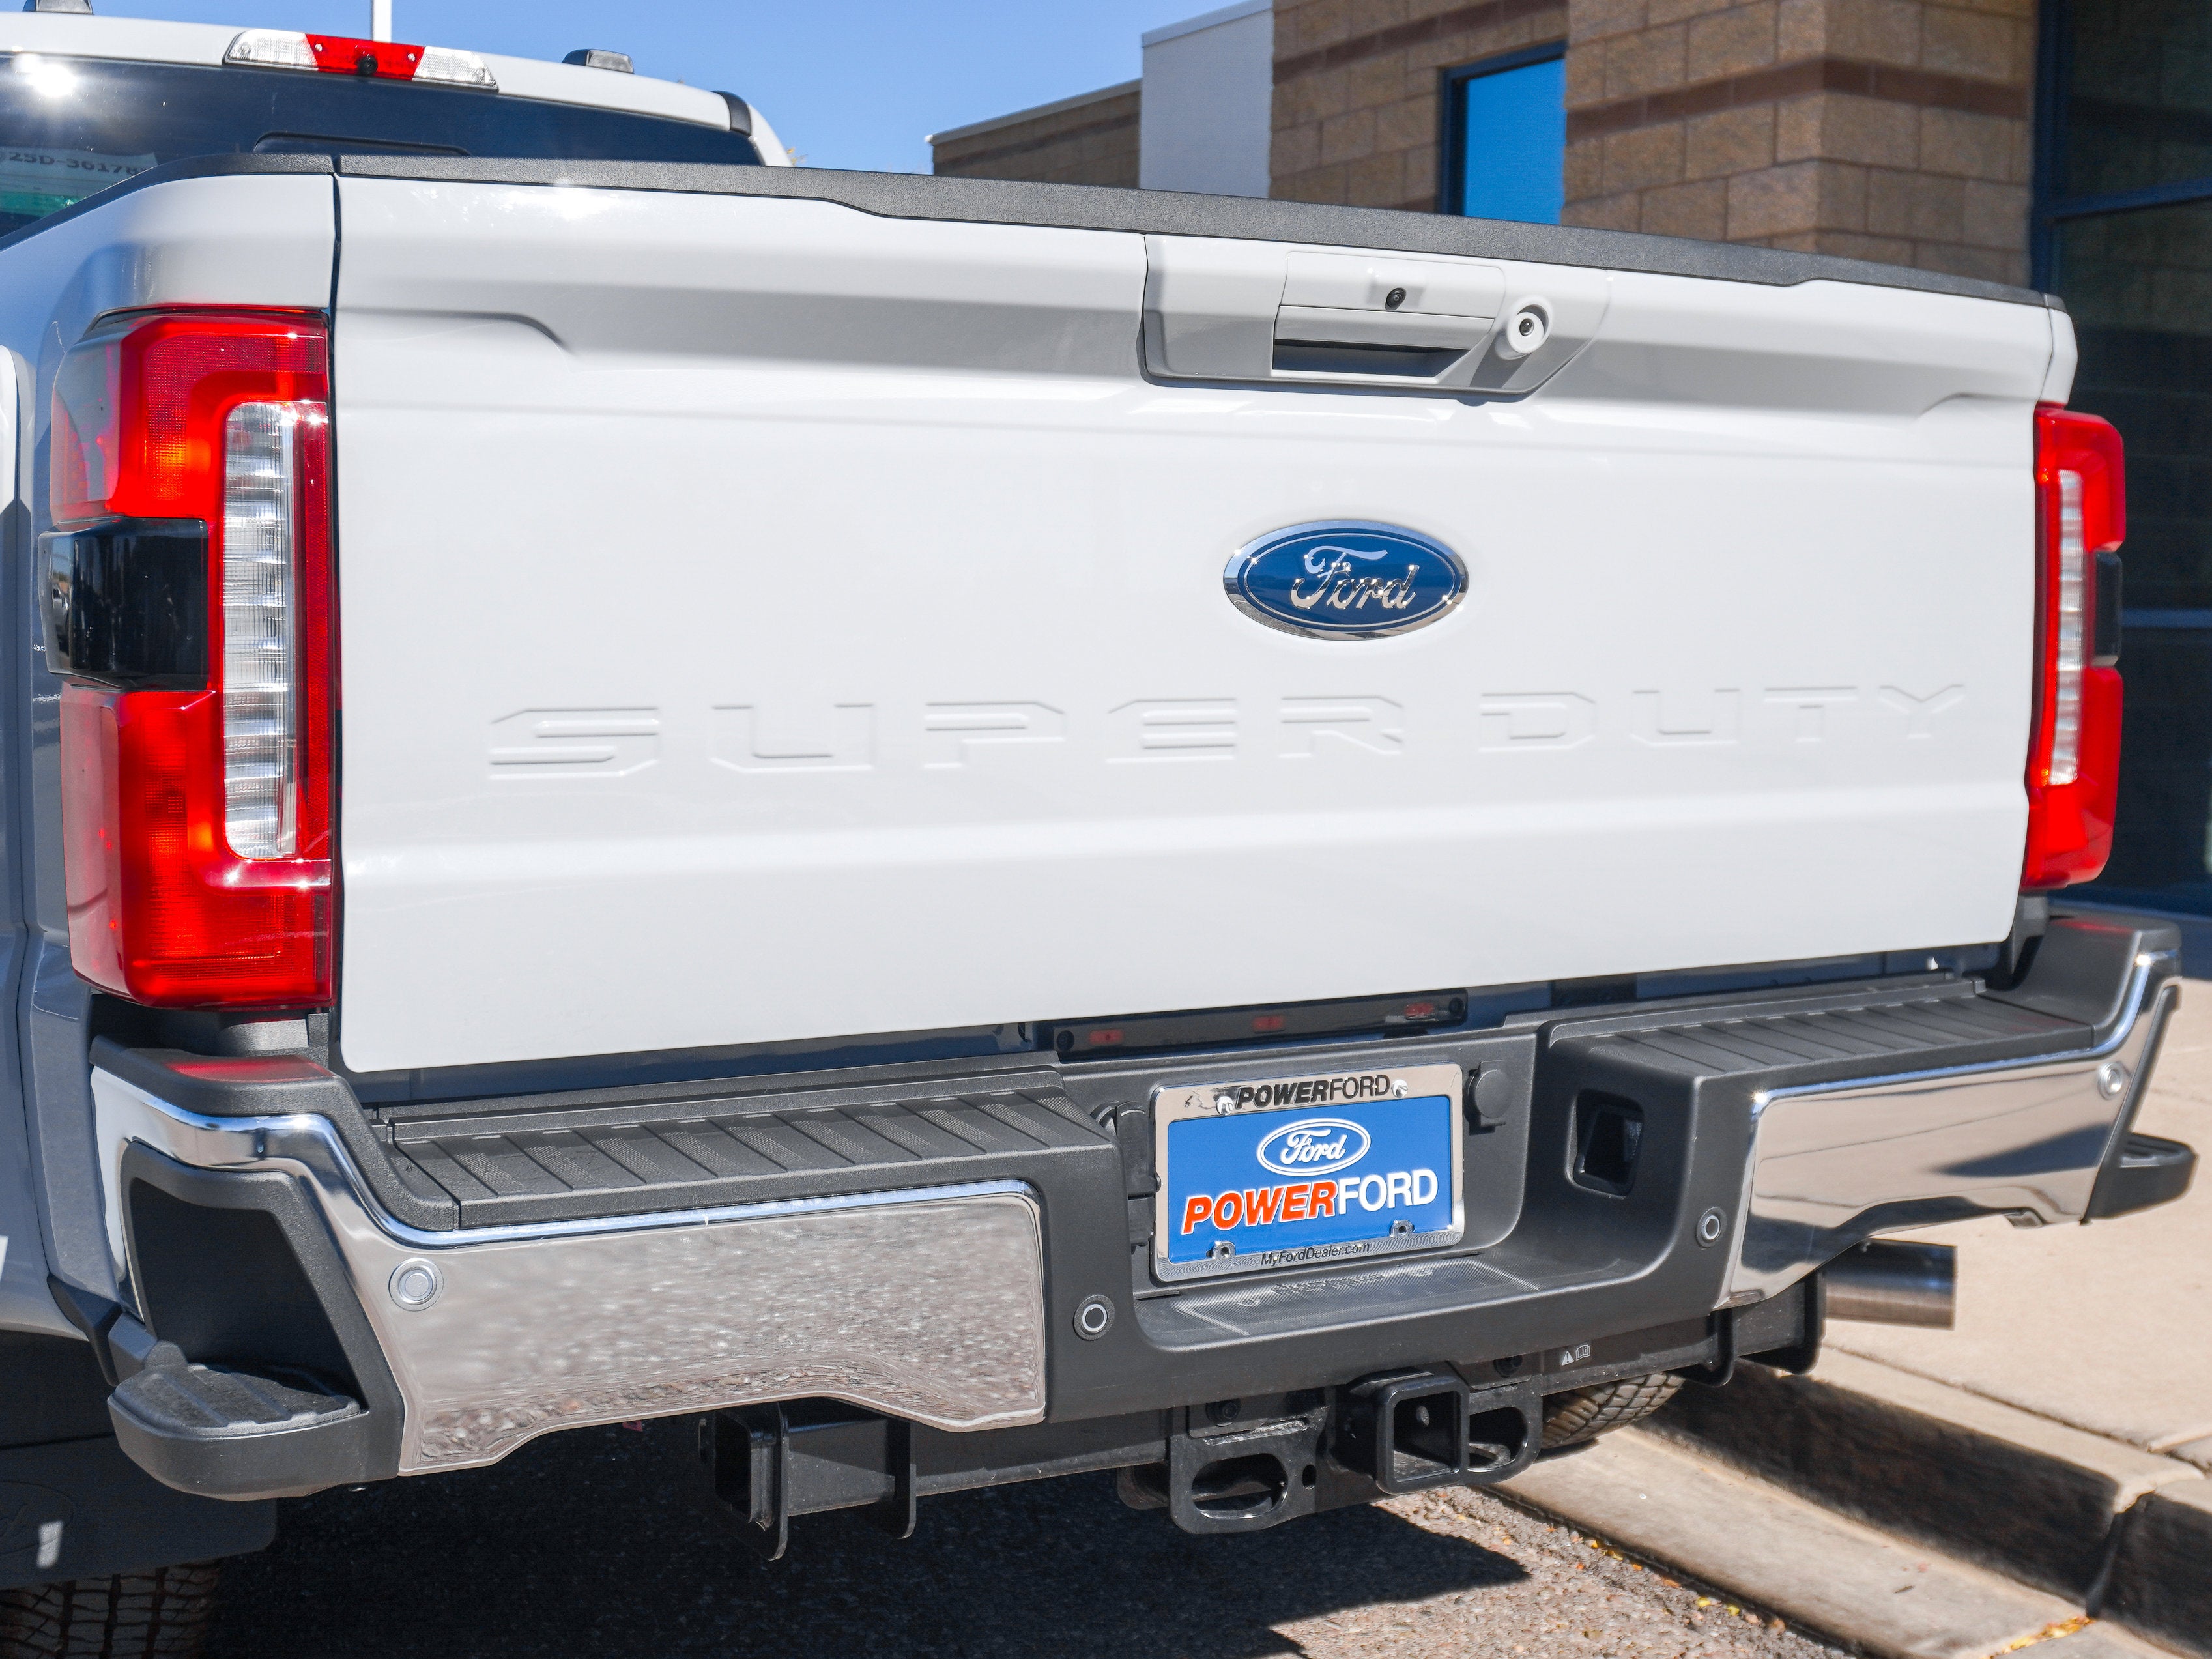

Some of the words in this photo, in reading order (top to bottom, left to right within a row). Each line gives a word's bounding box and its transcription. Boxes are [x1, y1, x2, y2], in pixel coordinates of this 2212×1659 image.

[1289, 545, 1420, 610] Ford
[487, 695, 1404, 780] SUPER
[1478, 683, 1966, 753] DUTY
[1235, 1074, 1390, 1109] POWERFORD
[1279, 1128, 1348, 1165] Ford
[1181, 1168, 1439, 1235] POWERFORD
[1261, 1243, 1370, 1267] MyFordDealer.com
